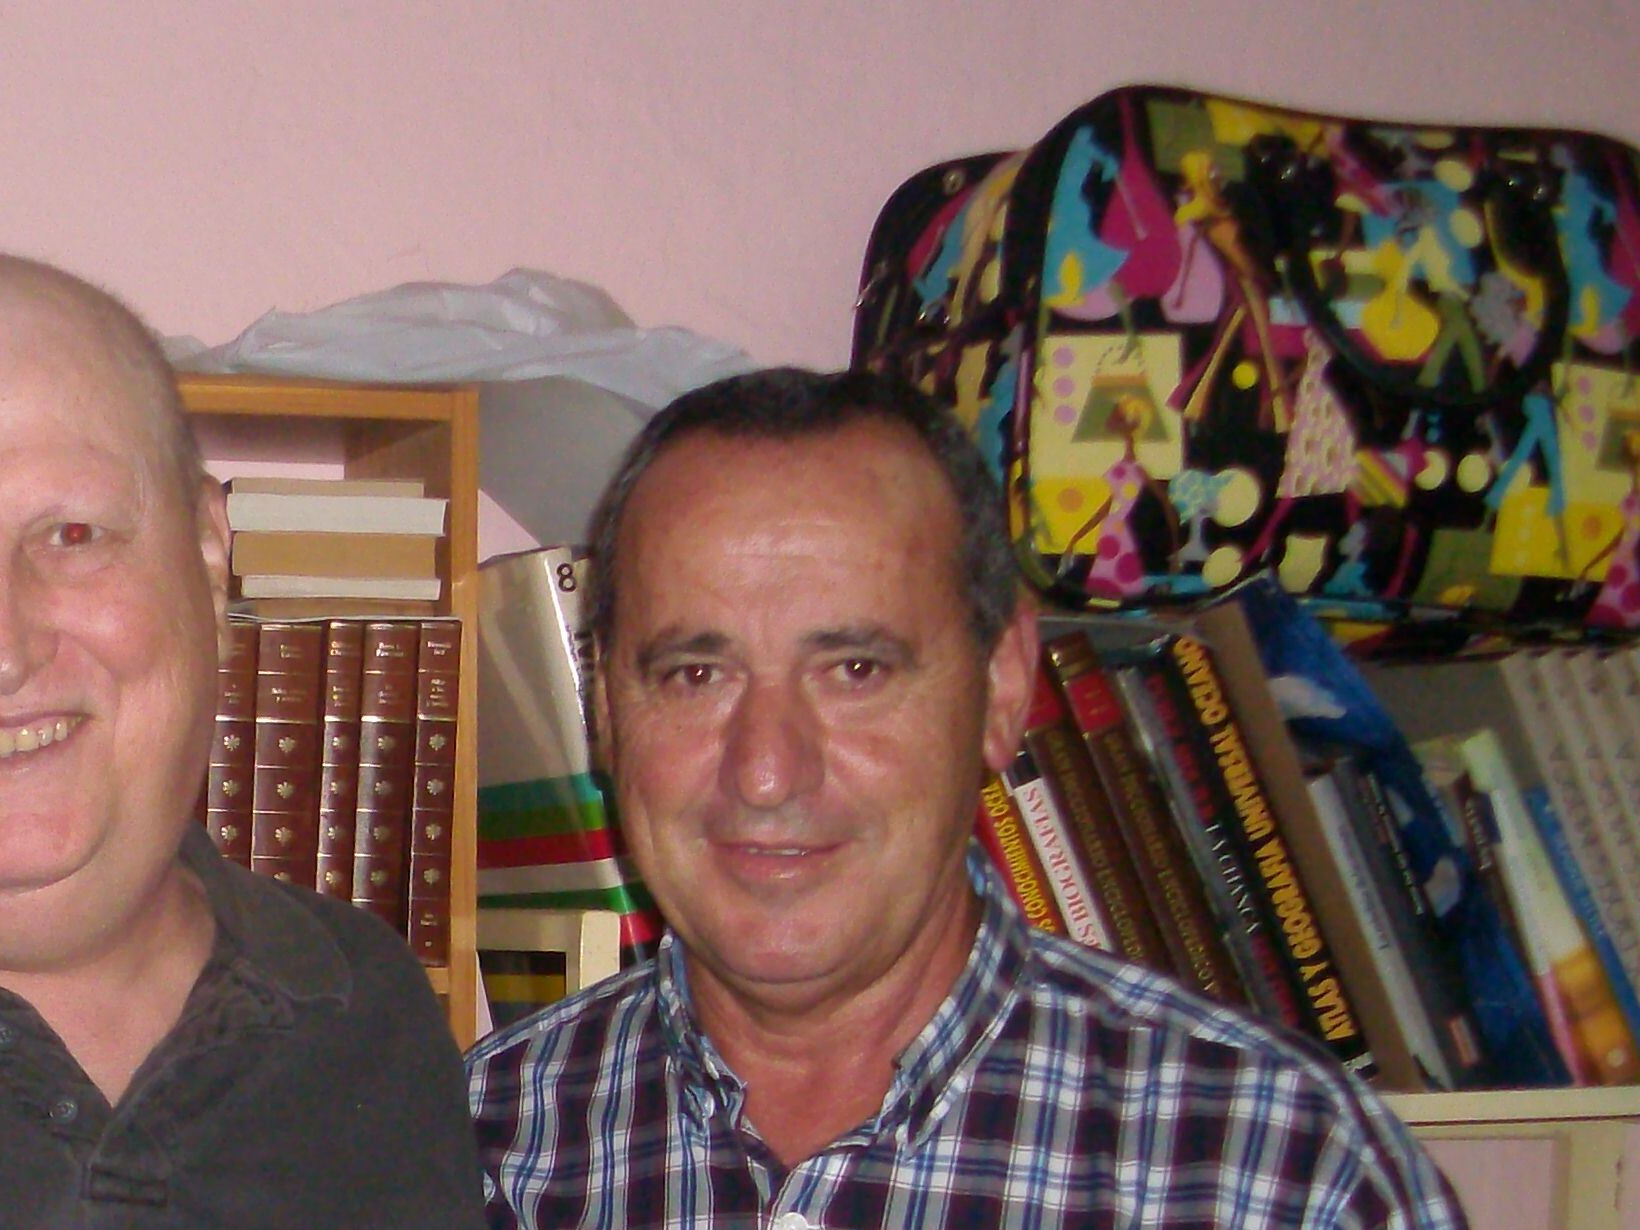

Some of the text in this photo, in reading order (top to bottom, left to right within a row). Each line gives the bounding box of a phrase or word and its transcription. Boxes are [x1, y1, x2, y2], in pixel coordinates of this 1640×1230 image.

[556, 562, 578, 593] 8
[1173, 635, 1229, 727] OCEANO
[980, 781, 1009, 818] OCEA
[1209, 724, 1276, 842] UNIVERSAL
[1253, 833, 1325, 960] GEOGRAFIA
[1298, 959, 1331, 983] Y
[1306, 976, 1356, 1042] ATLAS
